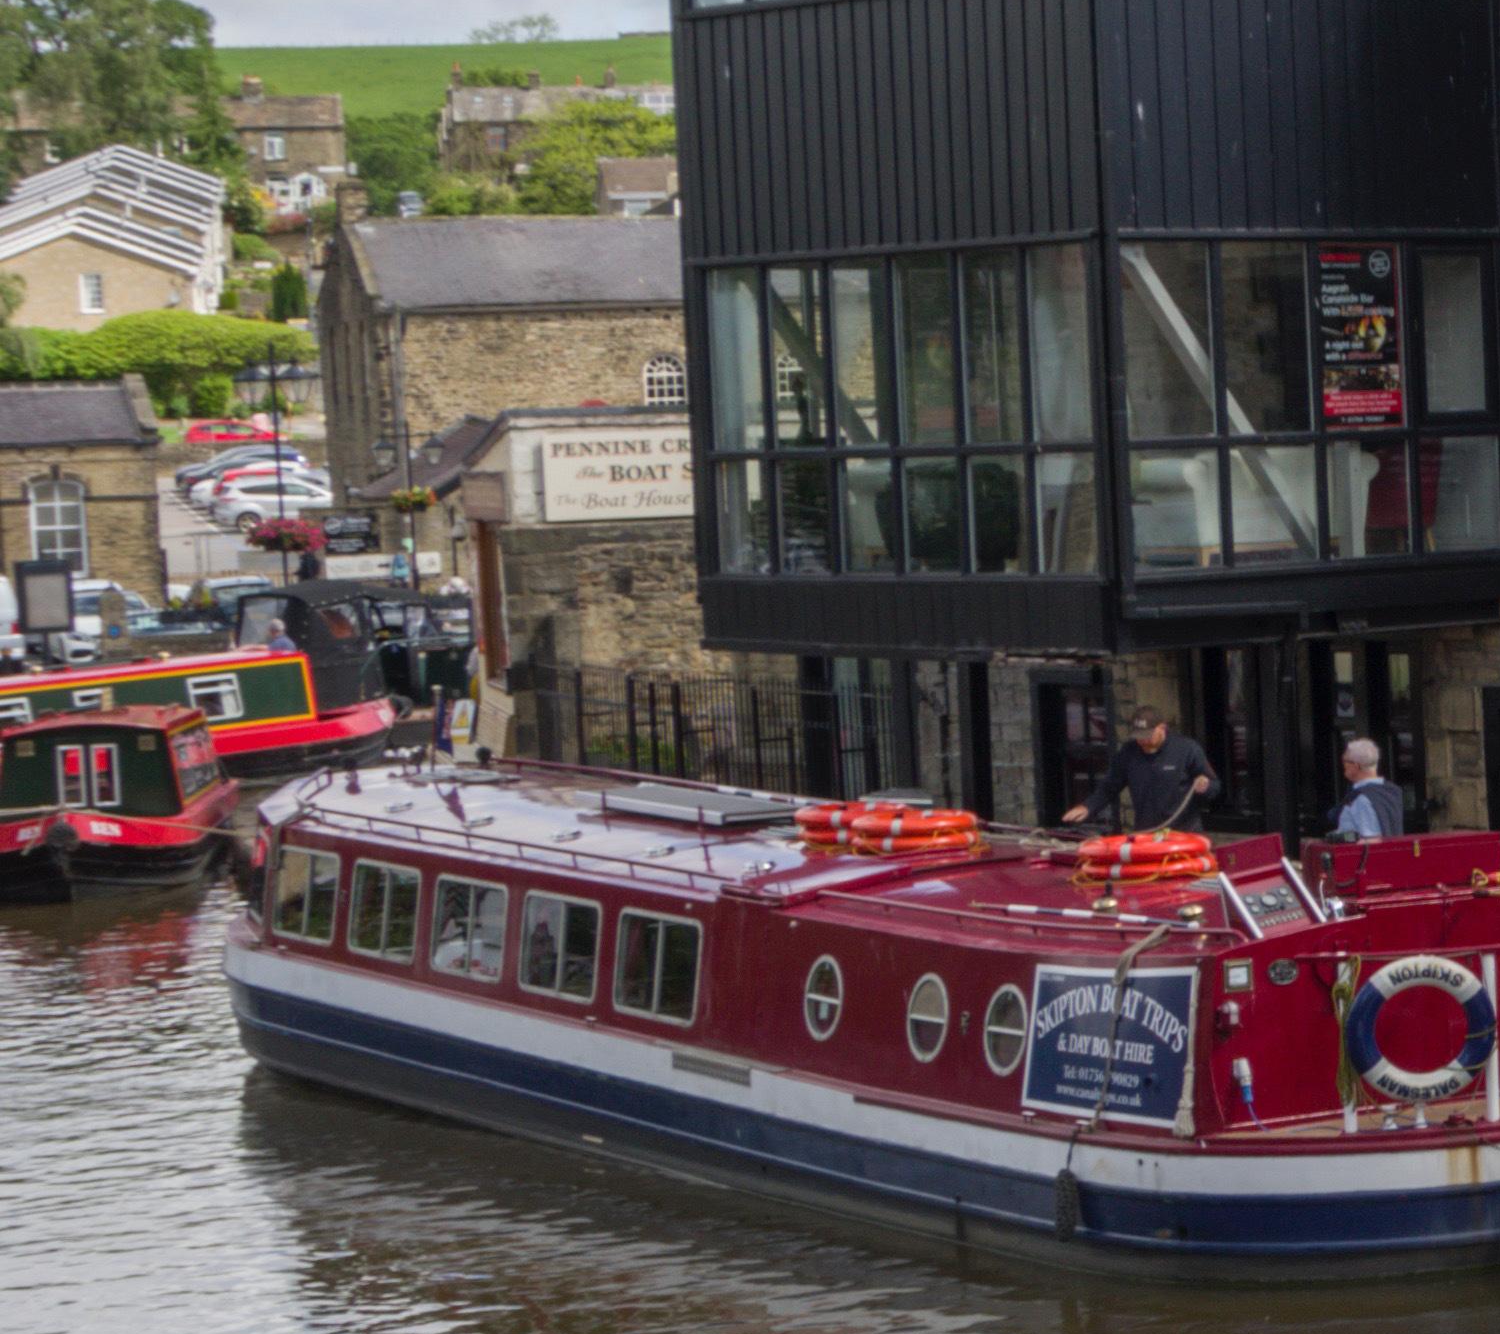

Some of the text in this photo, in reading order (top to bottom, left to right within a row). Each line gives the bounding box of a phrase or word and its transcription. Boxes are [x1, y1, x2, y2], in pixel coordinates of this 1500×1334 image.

[551, 440, 652, 457] PENNINE
[609, 464, 672, 483] BOAT
[1387, 966, 1466, 987] SKIPTON
[1036, 984, 1100, 1039] SKIPTON
[1142, 995, 1188, 1053] TRIPS
[1057, 1033, 1067, 1052] &
[1069, 1034, 1091, 1053] DAY
[1123, 1041, 1154, 1064] HIRE
[1112, 1071, 1140, 1087] 90829
[1377, 1074, 1461, 1100] DALESMAN
